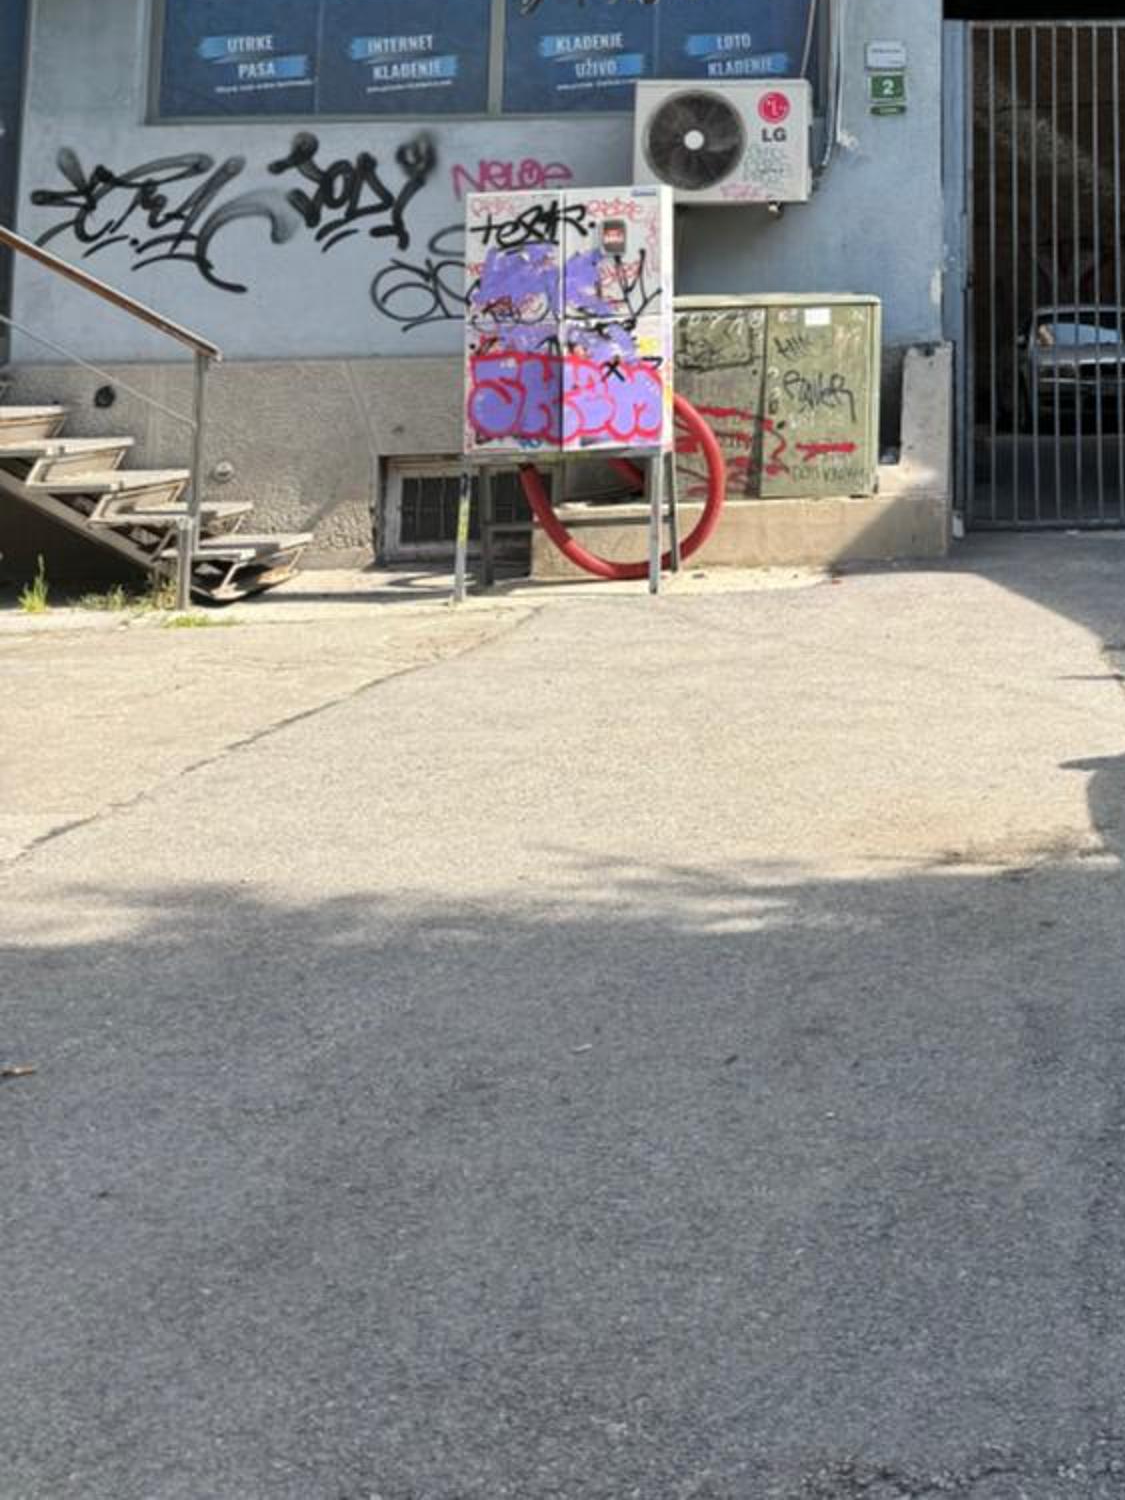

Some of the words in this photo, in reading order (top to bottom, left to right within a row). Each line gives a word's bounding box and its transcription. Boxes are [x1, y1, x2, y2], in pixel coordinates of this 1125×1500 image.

[226, 34, 273, 53] UTRKE
[367, 33, 433, 53] INTERNET
[716, 31, 751, 52] LOTO
[575, 57, 617, 78] UŽIVO
[882, 79, 895, 95] 2
[761, 127, 787, 143] LG
